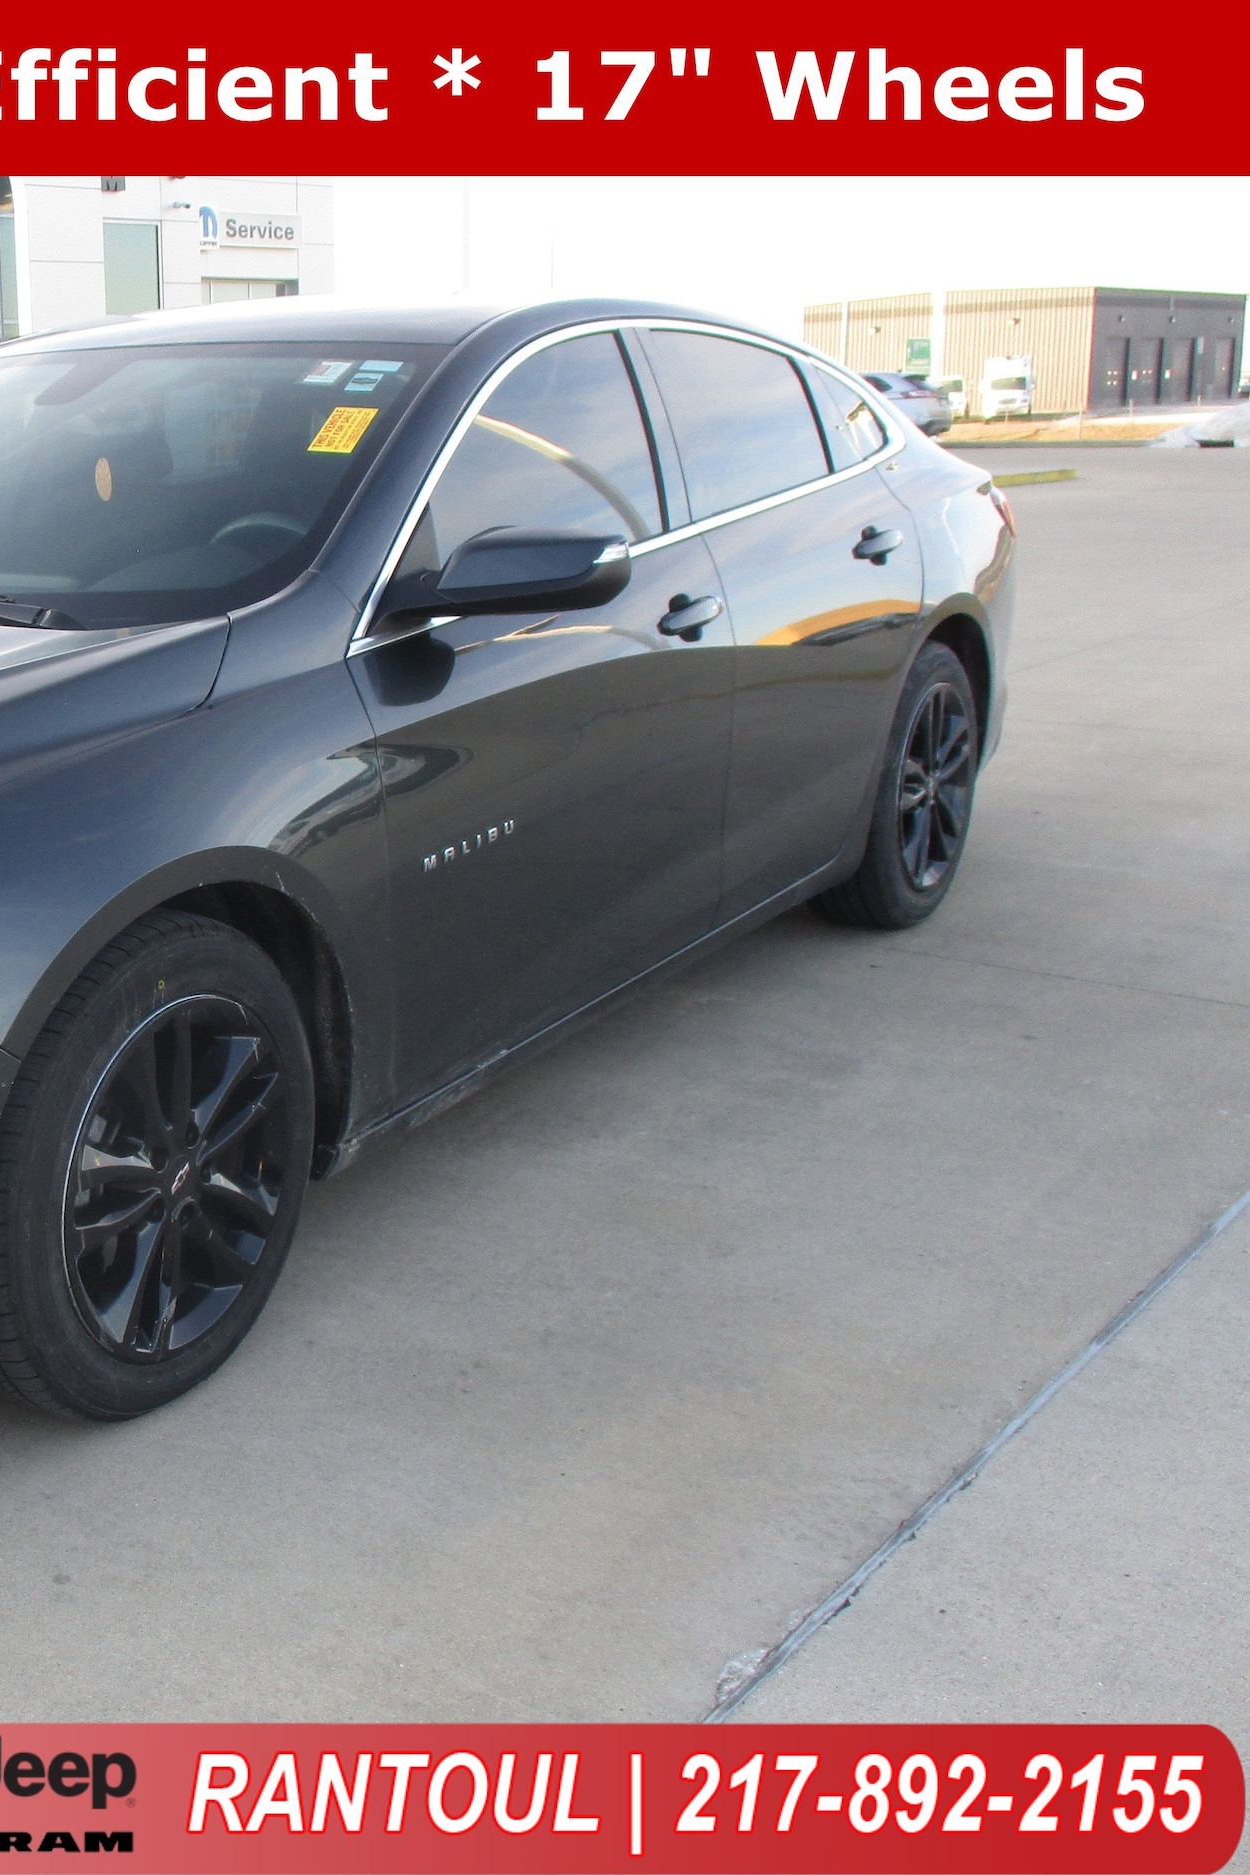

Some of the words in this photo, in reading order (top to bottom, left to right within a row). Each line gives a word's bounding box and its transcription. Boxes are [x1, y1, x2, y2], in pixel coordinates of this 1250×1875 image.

[225, 218, 294, 241] Service
[321, 409, 346, 433] VEHICLE
[421, 818, 516, 873] MALIBU
